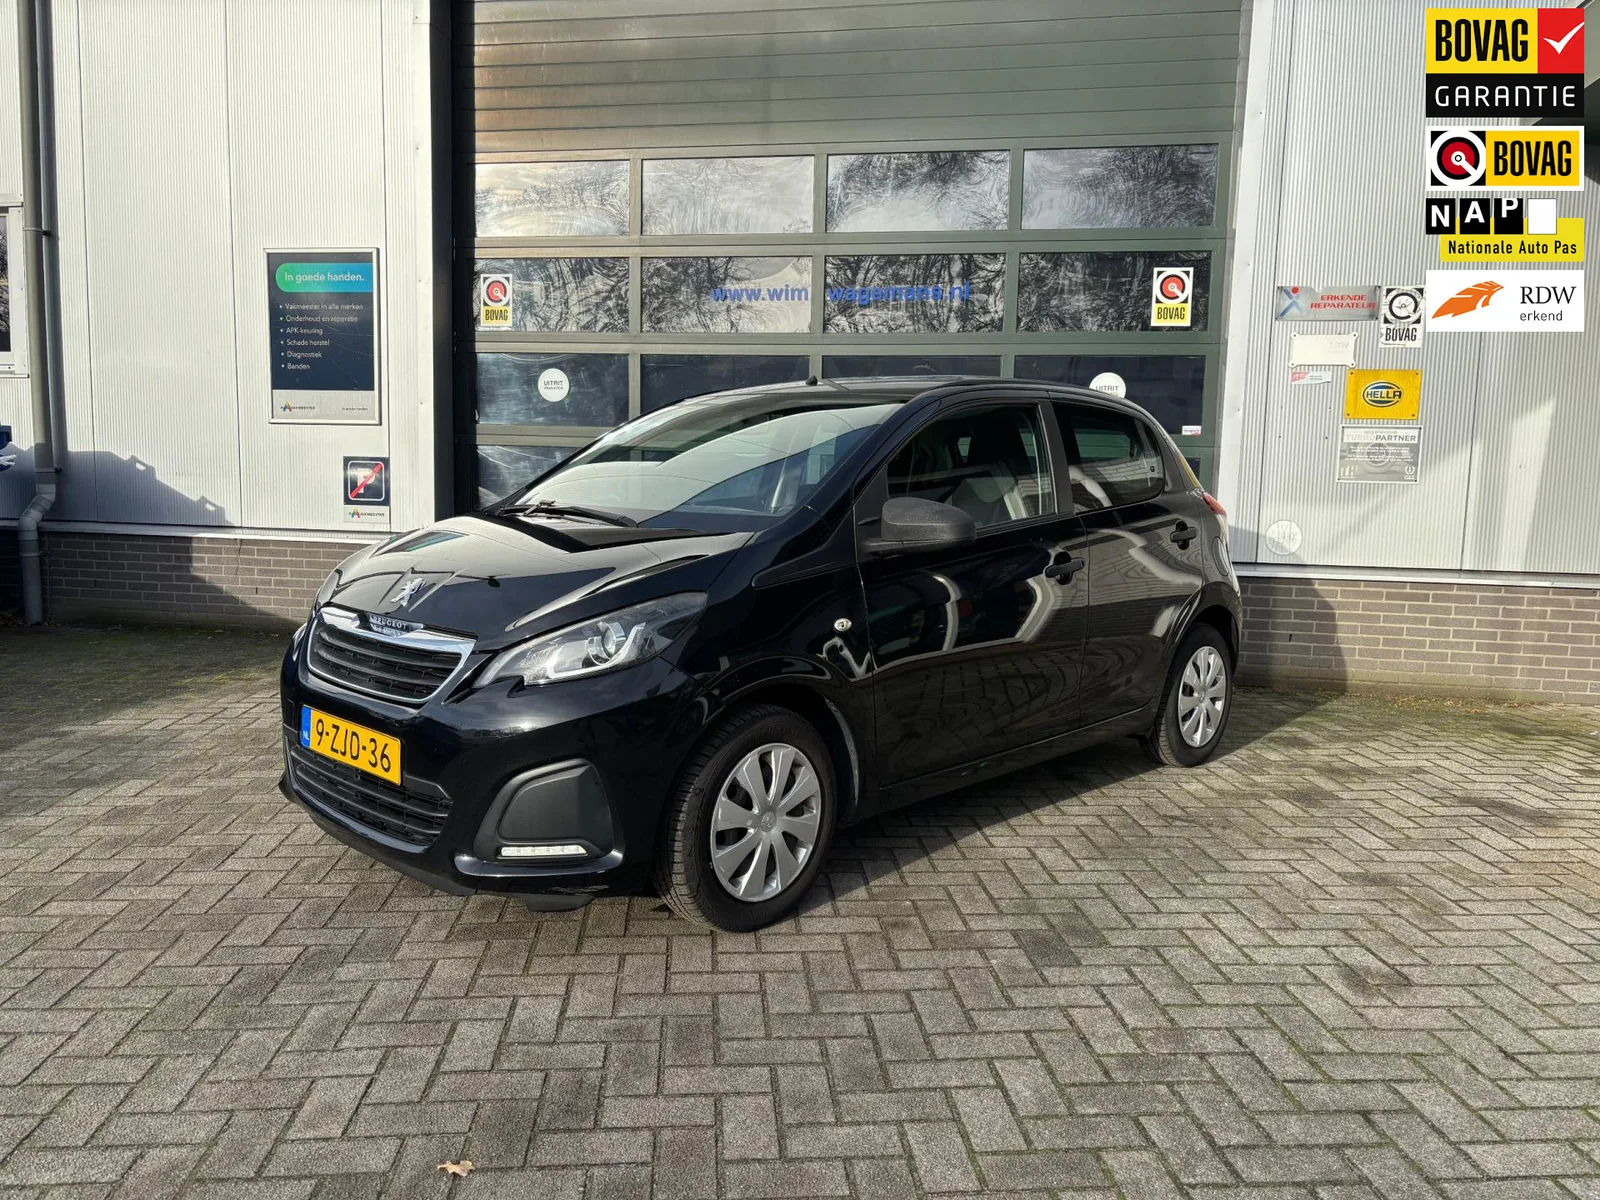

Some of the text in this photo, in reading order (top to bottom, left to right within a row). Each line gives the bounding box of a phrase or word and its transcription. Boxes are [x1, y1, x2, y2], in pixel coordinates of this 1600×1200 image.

[284, 272, 364, 284] In goede handen.
[485, 309, 508, 321] BOVAG
[1157, 306, 1186, 320] BOVAG
[1385, 327, 1417, 342] BOVAG
[1366, 390, 1402, 400] HELLA
[302, 718, 391, 773] NL 9-ZJD-36
